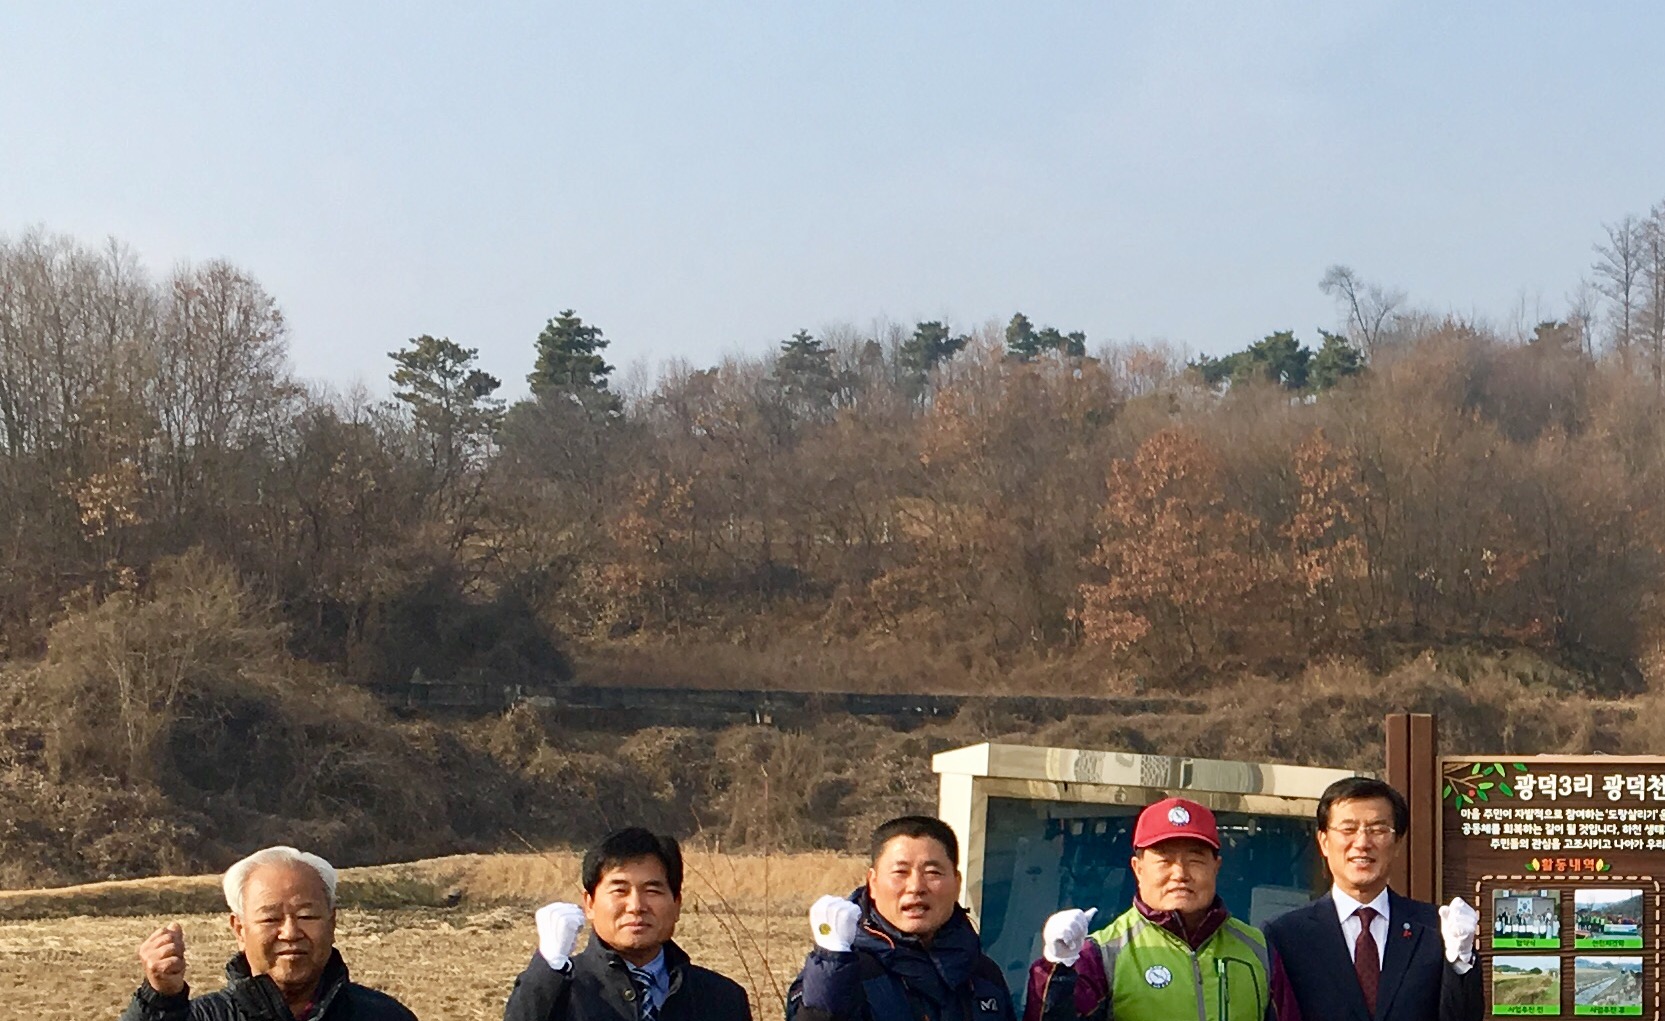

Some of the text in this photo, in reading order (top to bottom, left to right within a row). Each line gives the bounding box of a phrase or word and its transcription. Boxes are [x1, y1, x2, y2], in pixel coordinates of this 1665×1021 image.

[1514, 774, 1593, 800] 광덕3리
[1460, 808, 1481, 821] 마을
[1483, 808, 1512, 821] 주민이
[1515, 808, 1564, 821] 자발적으로
[1565, 808, 1604, 821] 참여하는
[1461, 823, 1501, 836] 공동체를
[1503, 823, 1542, 836] 회복하는
[1544, 823, 1564, 836] 길이
[1622, 823, 1642, 836] 하천
[1490, 838, 1529, 850] 주민들의
[1531, 838, 1561, 850] 관심을
[1563, 838, 1612, 850] 고조시키고
[1614, 838, 1644, 850] 나아가
[1541, 858, 1596, 872] 활동내역
